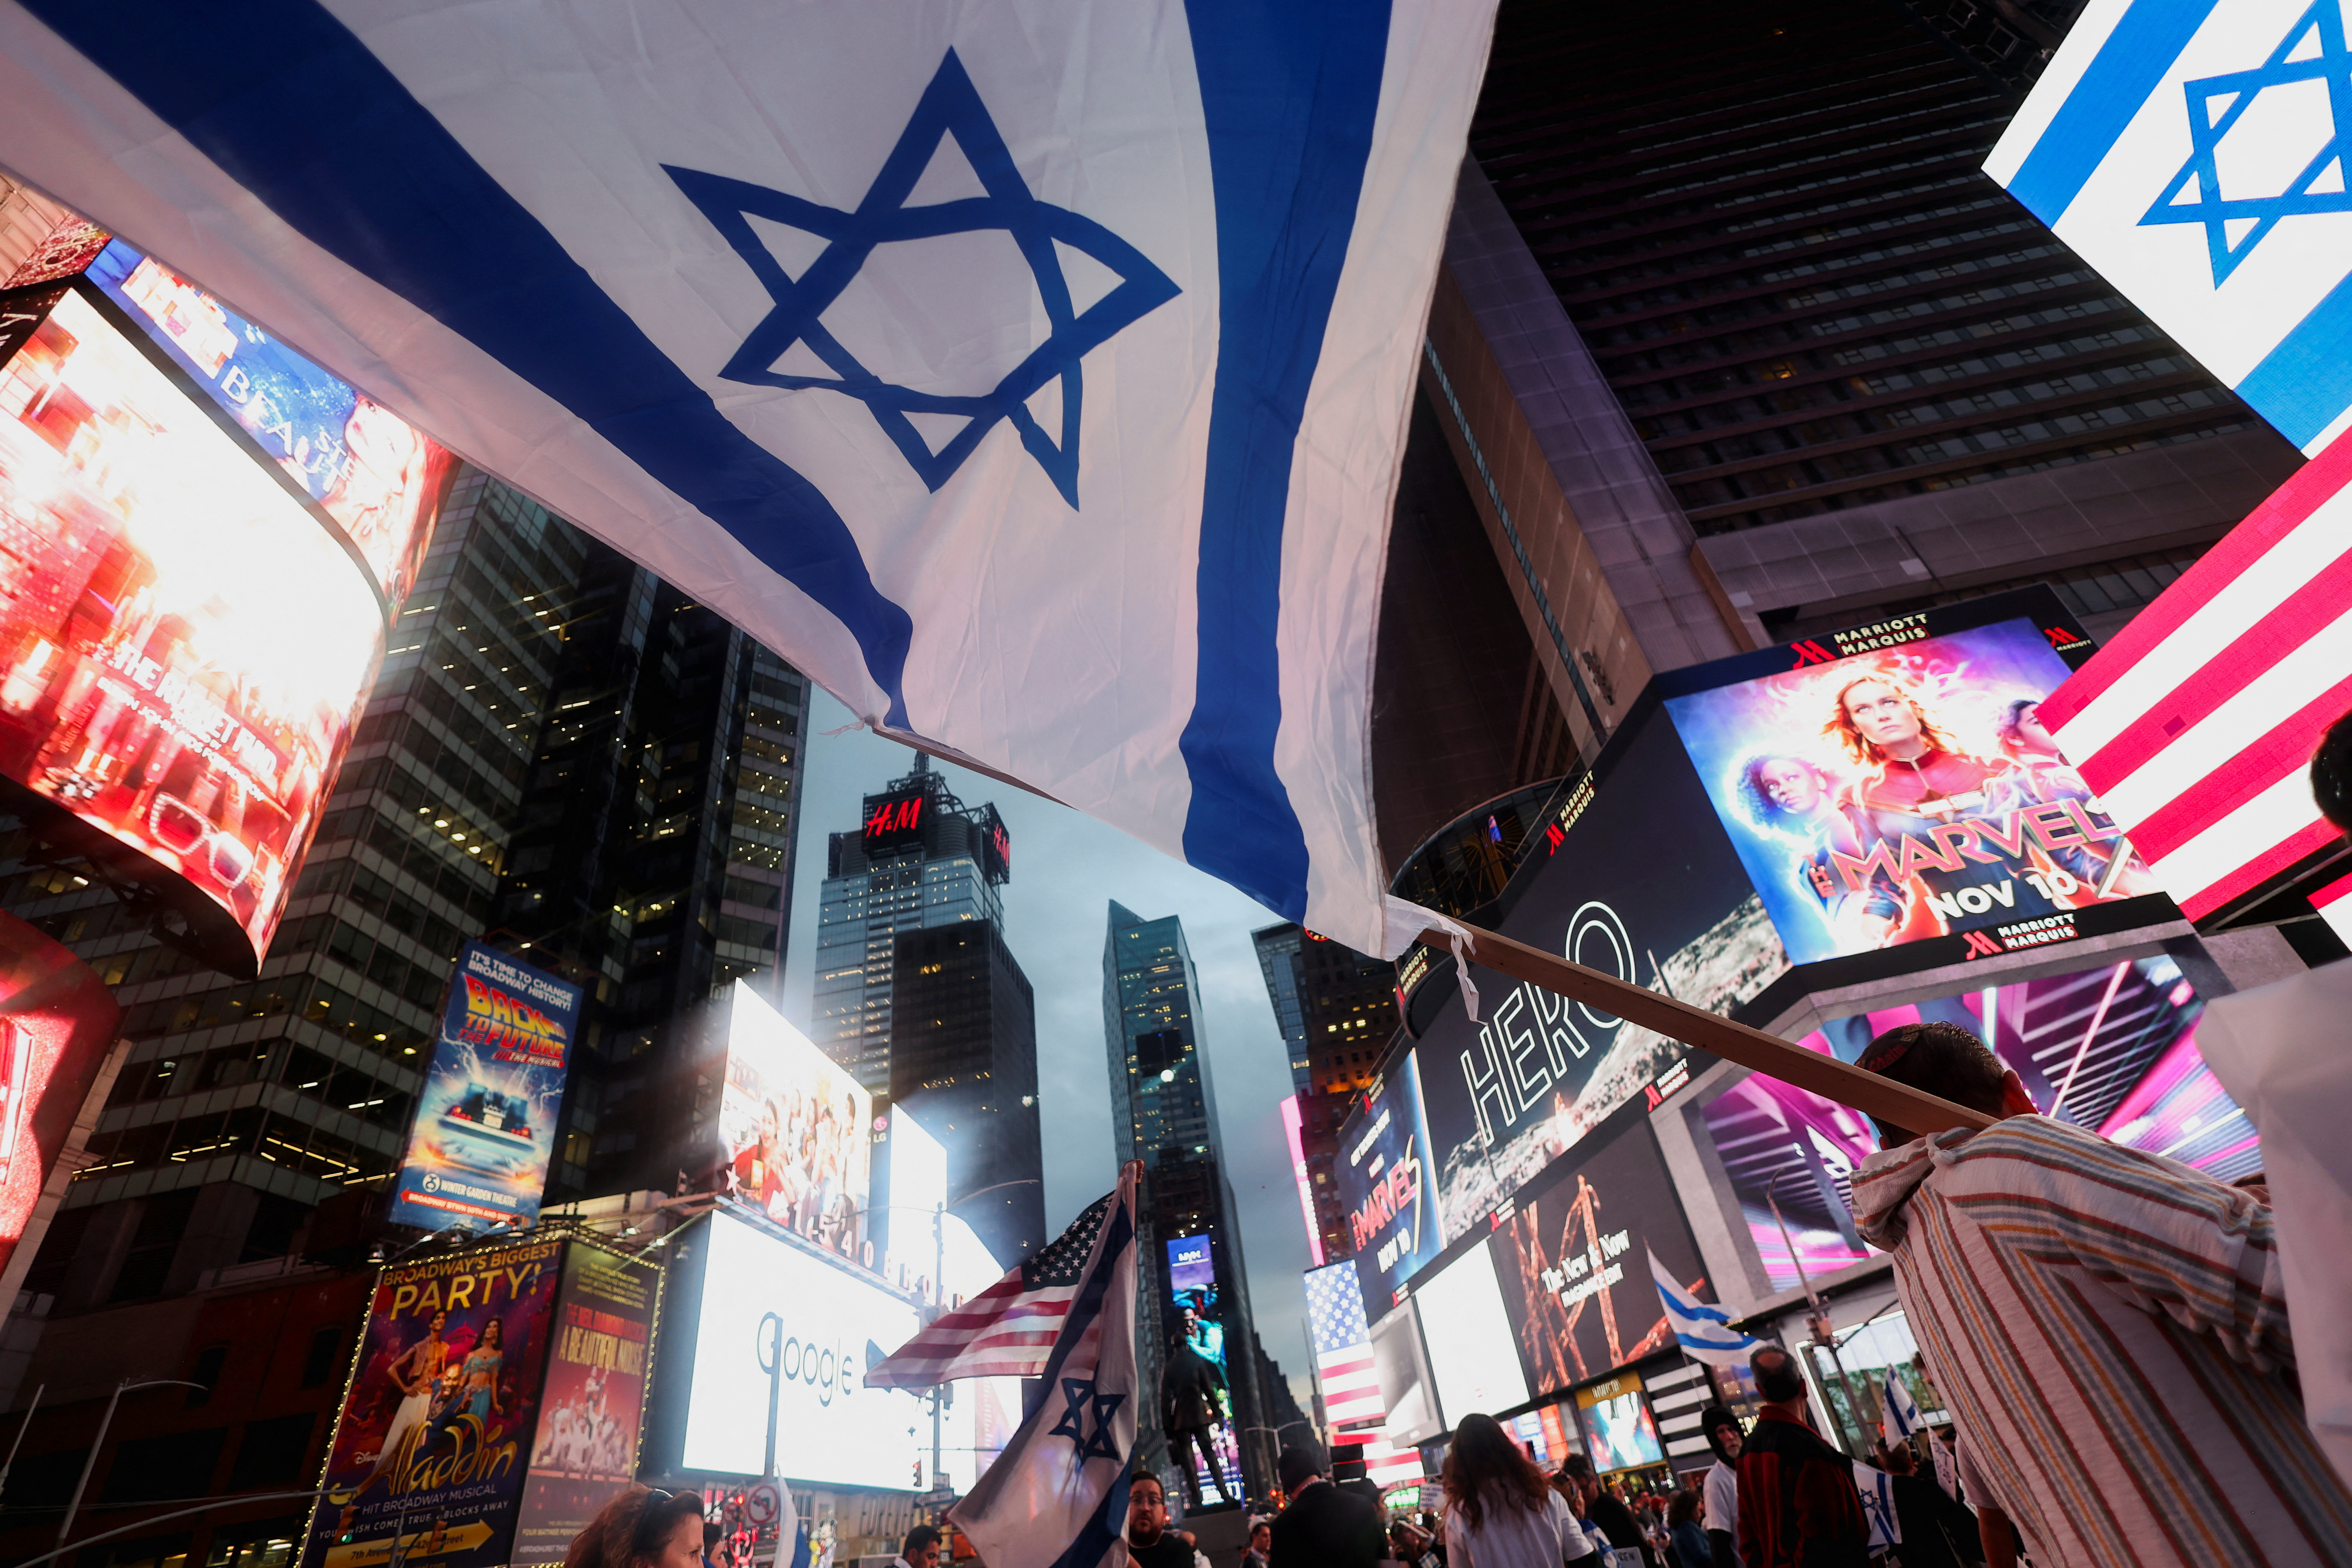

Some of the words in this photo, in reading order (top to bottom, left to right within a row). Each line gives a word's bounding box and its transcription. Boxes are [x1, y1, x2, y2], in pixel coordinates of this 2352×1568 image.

[1834, 613, 1927, 644] MARRIOTT
[1841, 627, 1927, 655] MARQUIS
[2056, 639, 2092, 652] MARRIOTT
[114, 641, 162, 691] THE
[155, 672, 239, 743] ROCKET
[232, 727, 277, 778] FUND
[137, 706, 177, 735] JOHN
[201, 747, 265, 802] FOUNDATION
[866, 797, 922, 837] H&M
[1560, 770, 1593, 821] MARRIOTT
[1564, 787, 1595, 833] MARQUIS
[994, 823, 1010, 868] H&M
[1805, 853, 1837, 899] THE
[1925, 879, 2015, 921] NOV
[2025, 869, 2079, 901] 10
[1997, 913, 2075, 937] MARRIOTT
[2004, 926, 2075, 948] MARQUIS
[468, 960, 528, 992] BROADWAY
[528, 986, 572, 1011] HISTORY!
[471, 950, 490, 966] IT'S
[493, 960, 517, 974] TIME
[518, 971, 532, 983] TO
[533, 978, 573, 1002] CHANGE
[1400, 946, 1427, 985] MARRIOTT
[1403, 962, 1427, 995] MARQUIS
[462, 972, 556, 1038] BACK
[466, 1012, 490, 1032] TO
[1460, 901, 1636, 1147] HERO
[457, 1028, 485, 1044] THE
[484, 1020, 566, 1059] FUTURE
[509, 1052, 527, 1063] THE
[527, 1055, 560, 1068] MUSICAL
[1656, 1058, 1688, 1087] MARRIOTT
[1660, 1070, 1690, 1098] MARQUIS
[873, 1133, 887, 1143] LG
[408, 1193, 447, 1208] BROADWAY
[446, 1201, 467, 1212] BTWN
[483, 1210, 497, 1219] AND
[440, 1180, 467, 1196] WINTER
[466, 1187, 492, 1202] GARDEN
[492, 1193, 518, 1208] THEATRE
[1355, 1134, 1422, 1254] MARVELS
[1350, 1212, 1363, 1251] THE
[1377, 1237, 1399, 1273] NOV
[1397, 1227, 1411, 1255] 10
[384, 1255, 487, 1285] BROADWAY'S
[490, 1242, 561, 1268] BIGGEST
[1541, 1267, 1565, 1293] The
[1561, 1254, 1589, 1283] New
[1587, 1244, 1603, 1267] &
[1599, 1229, 1630, 1261] Now
[390, 1262, 542, 1320] PARTY!
[1561, 1273, 1607, 1308] FRAGRANCE
[1603, 1263, 1624, 1285] EDIT
[567, 1326, 619, 1372] BEAUTIFUL
[757, 1311, 852, 1407] Google
[329, 1413, 518, 1505] Aladdin
[319, 1529, 338, 1539] YOU
[373, 1518, 400, 1530] COME
[408, 1513, 432, 1525] TRUE
[443, 1504, 479, 1519] BLOCKS
[482, 1500, 509, 1512] AWAY
[362, 1503, 380, 1515] HIT
[382, 1492, 445, 1513] BROADWAY
[449, 1484, 497, 1502] MUSICAL
[351, 1550, 364, 1560] 7th
